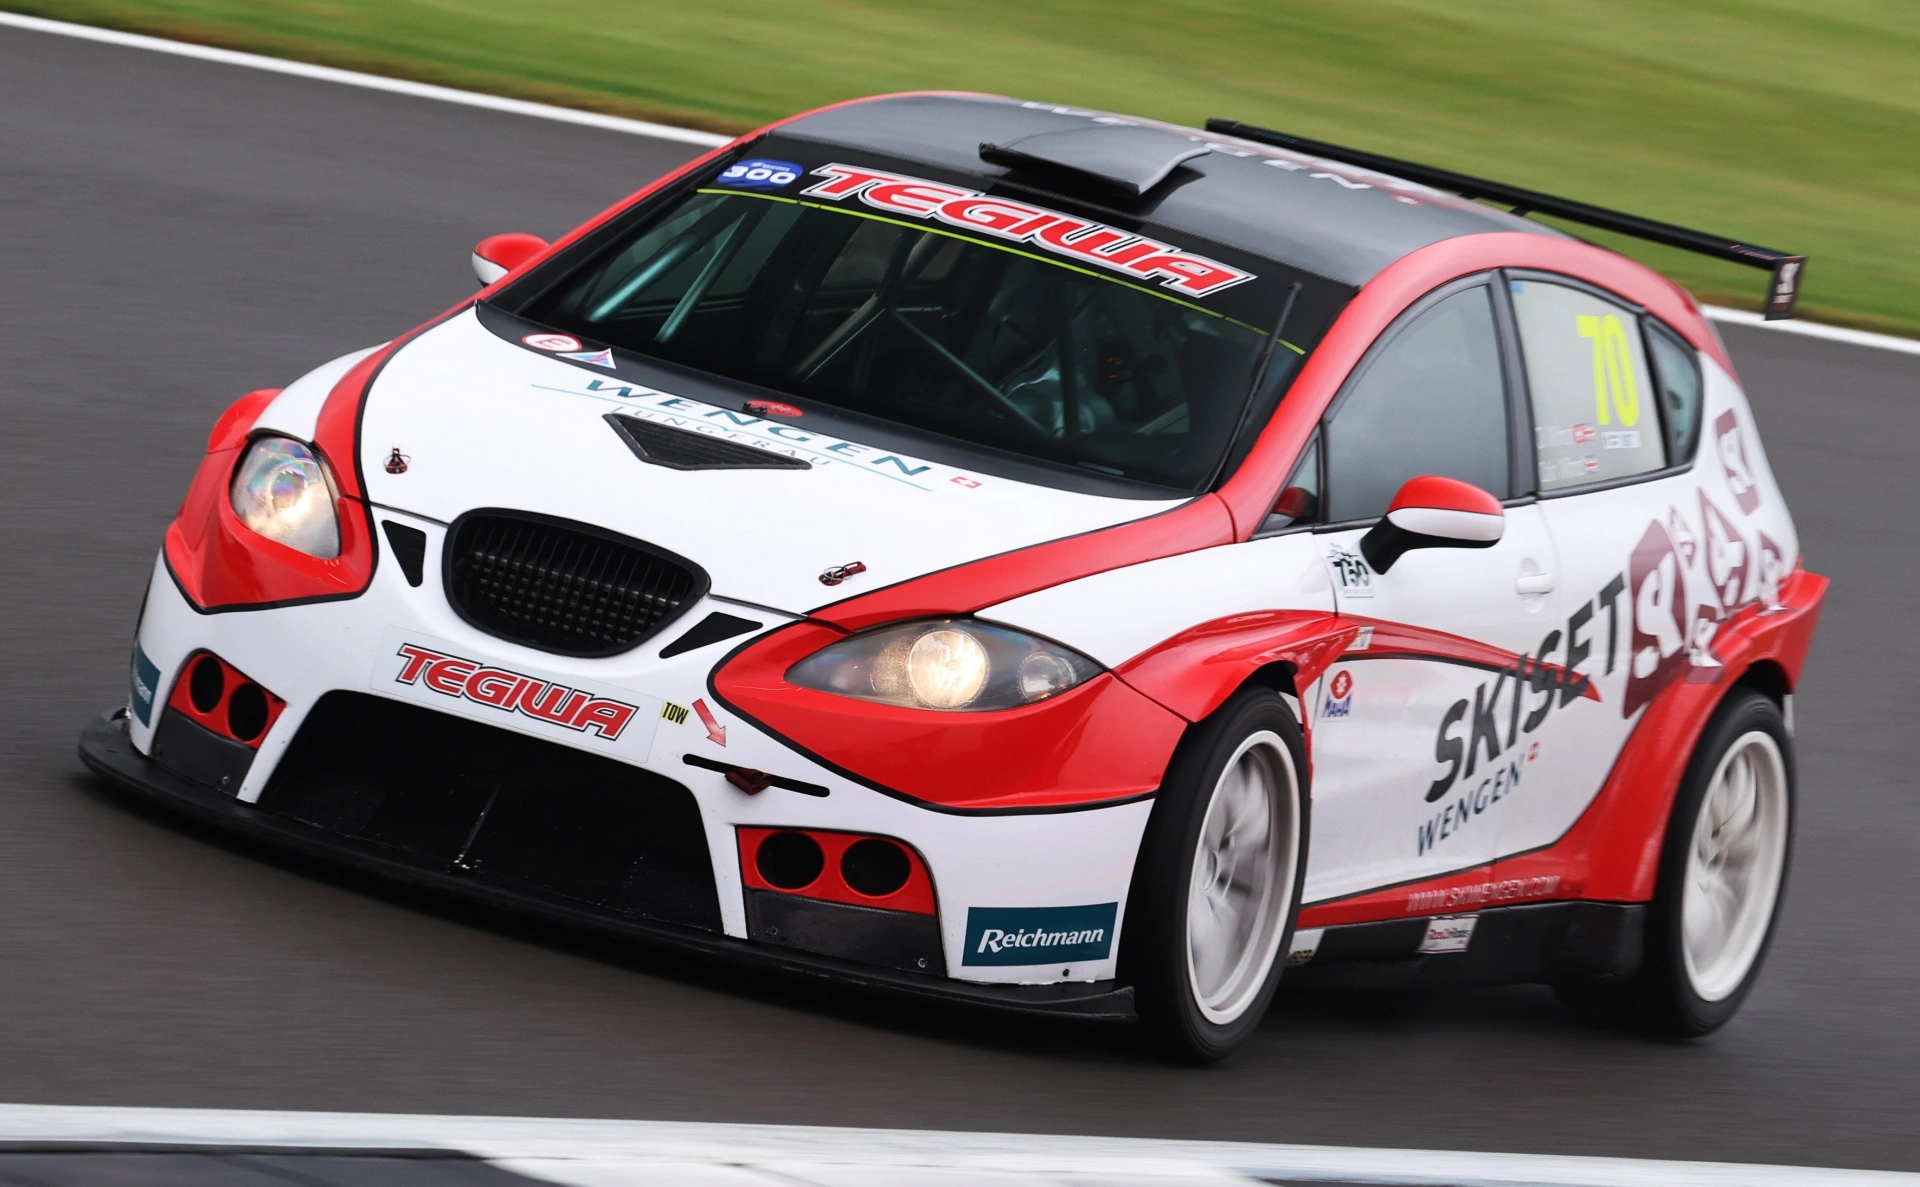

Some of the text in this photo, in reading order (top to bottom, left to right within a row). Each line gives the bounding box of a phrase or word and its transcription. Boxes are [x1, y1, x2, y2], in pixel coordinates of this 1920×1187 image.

[722, 165, 797, 185] 300
[799, 162, 1258, 299] TEGIWA
[1575, 313, 1640, 428] 70
[586, 379, 932, 477] WENGEN
[608, 405, 831, 467] JUNGFRAU
[397, 643, 640, 741] TEGIWA
[662, 701, 690, 725] TOW
[1424, 571, 1627, 803] SKISET
[1417, 753, 1526, 857] WENGEN
[977, 927, 1104, 954] Reichmann
